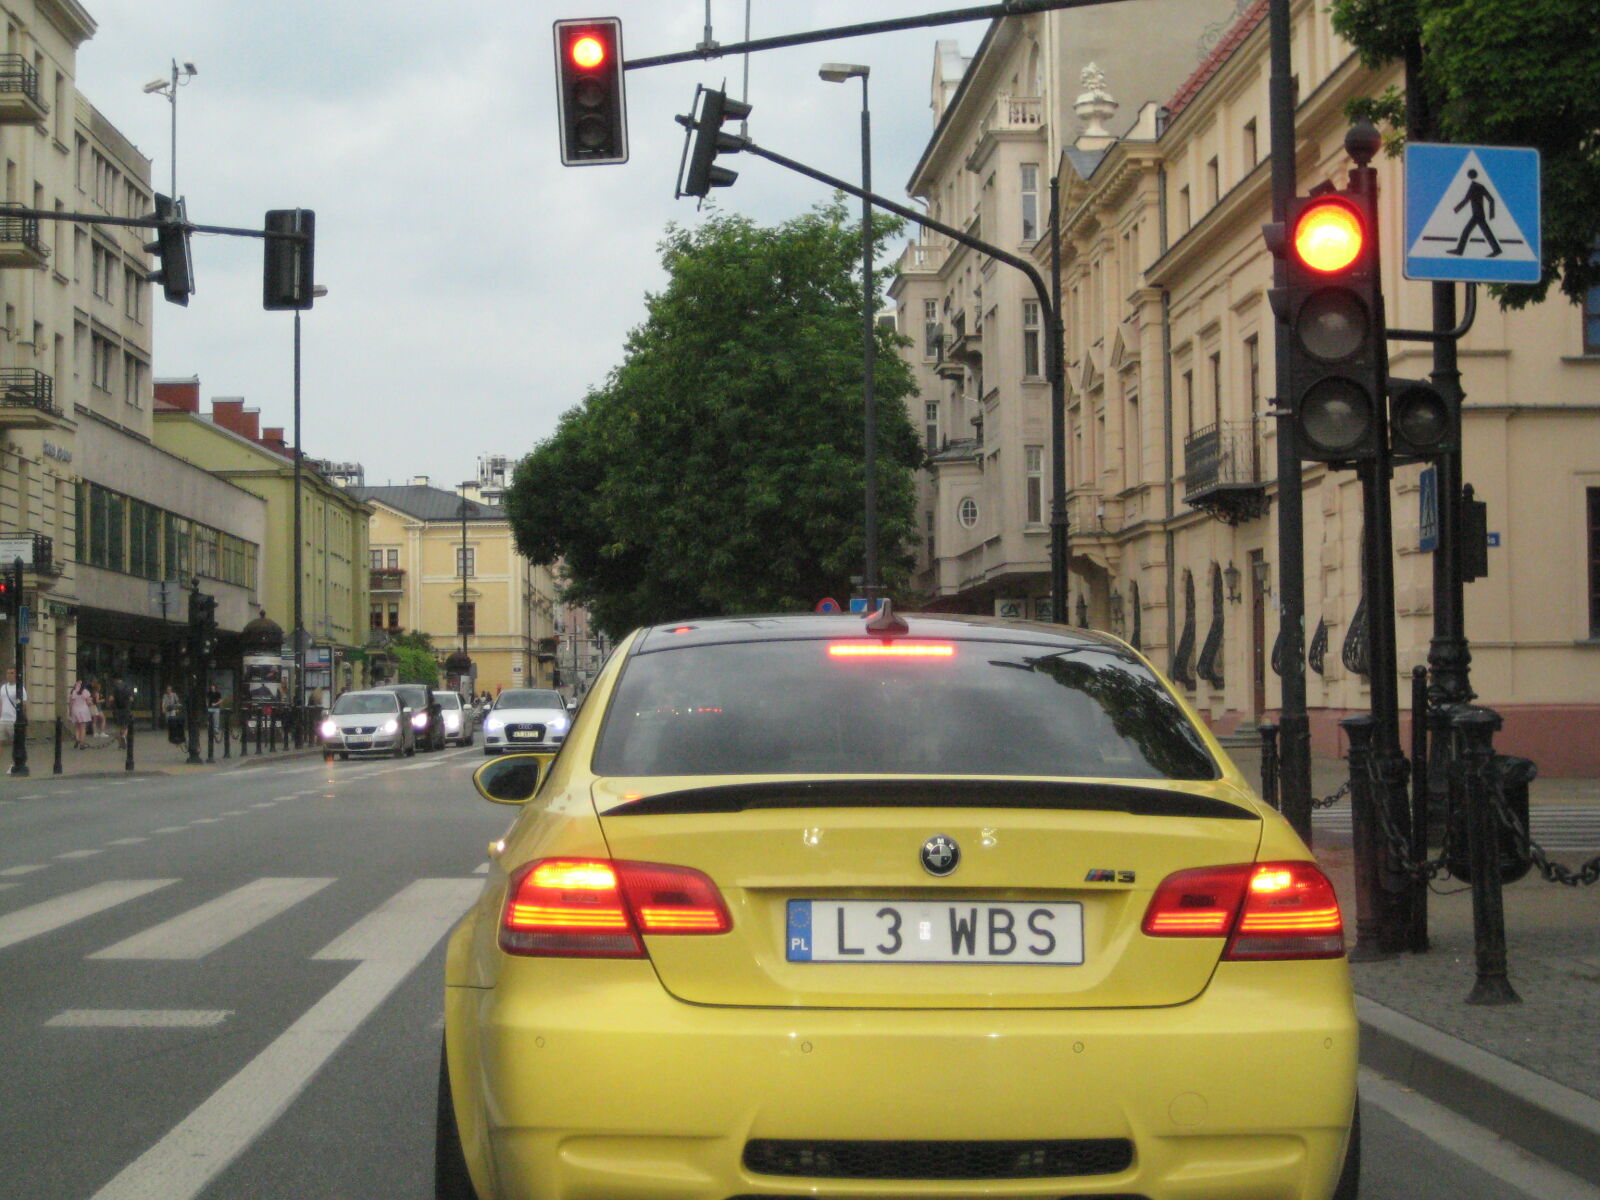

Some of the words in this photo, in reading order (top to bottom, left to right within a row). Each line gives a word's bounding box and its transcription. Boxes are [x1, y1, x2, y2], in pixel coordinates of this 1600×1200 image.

[791, 937, 809, 951] PL
[837, 907, 903, 955] L3
[949, 907, 1056, 956] WBS
